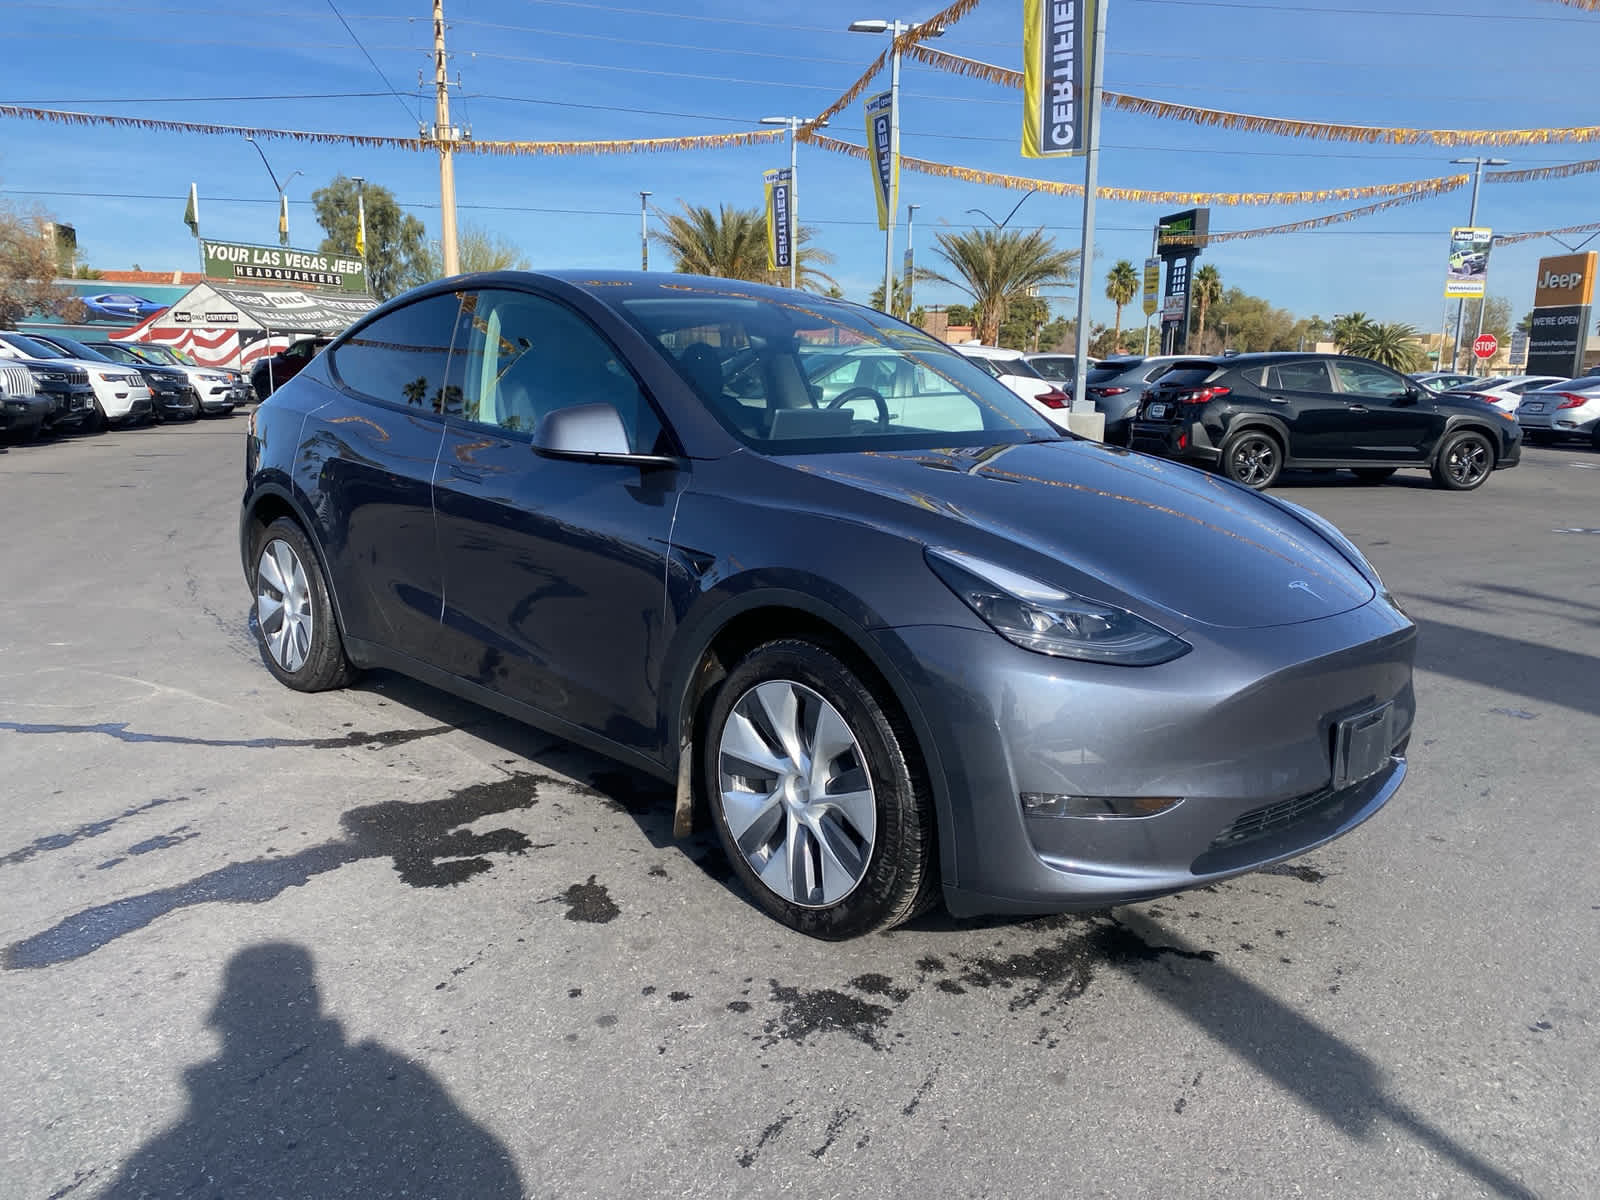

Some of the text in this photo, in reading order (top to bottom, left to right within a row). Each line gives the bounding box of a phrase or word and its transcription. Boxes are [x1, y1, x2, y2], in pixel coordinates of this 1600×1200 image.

[1455, 231, 1473, 240] Jeep
[206, 244, 363, 275] YOUR LAS VEGAS JEEP
[236, 266, 342, 285] HEADQUARTERS
[1538, 270, 1582, 290] Jeep
[228, 291, 269, 306] Jeep
[270, 295, 309, 305] ONLY
[175, 313, 191, 321] Jeep
[1475, 341, 1496, 351] STOP
